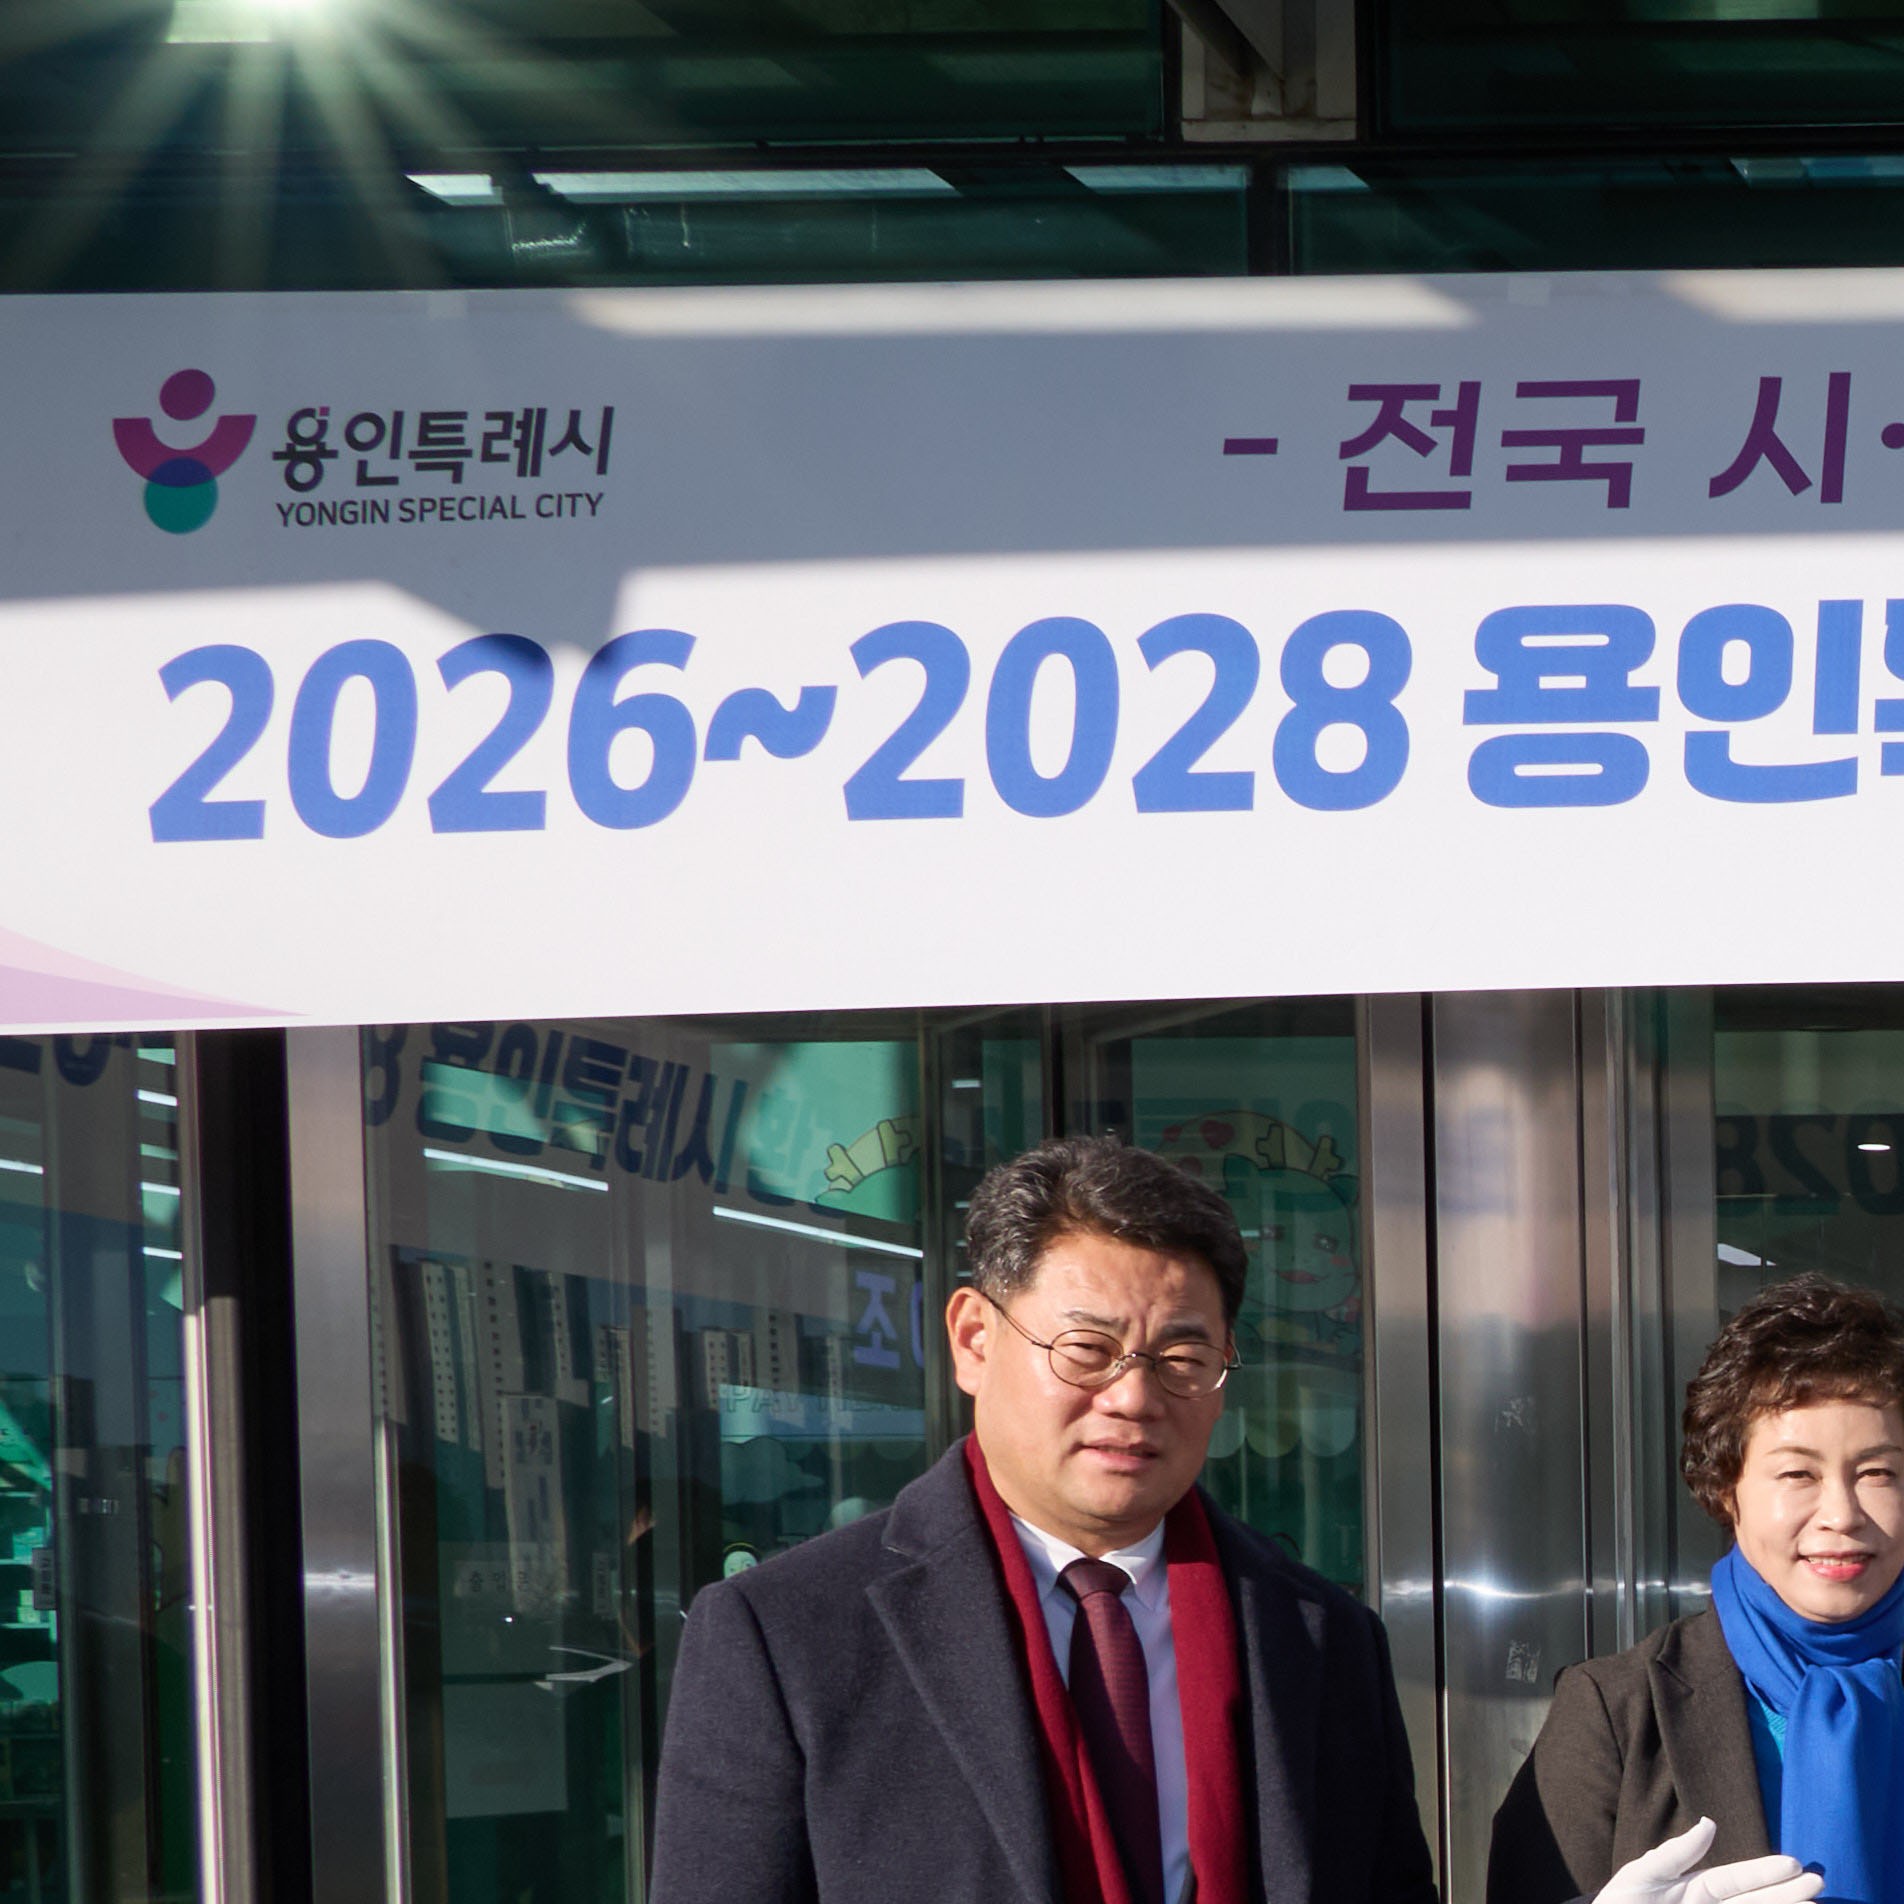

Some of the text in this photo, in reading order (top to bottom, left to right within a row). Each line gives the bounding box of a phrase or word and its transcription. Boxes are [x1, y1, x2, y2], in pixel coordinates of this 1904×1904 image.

[273, 406, 614, 492] 용인특례시
[1339, 379, 1643, 510] 전국
[276, 492, 604, 528] YONGIN SPECIAL CITY
[151, 608, 1412, 841] 2026~2028
